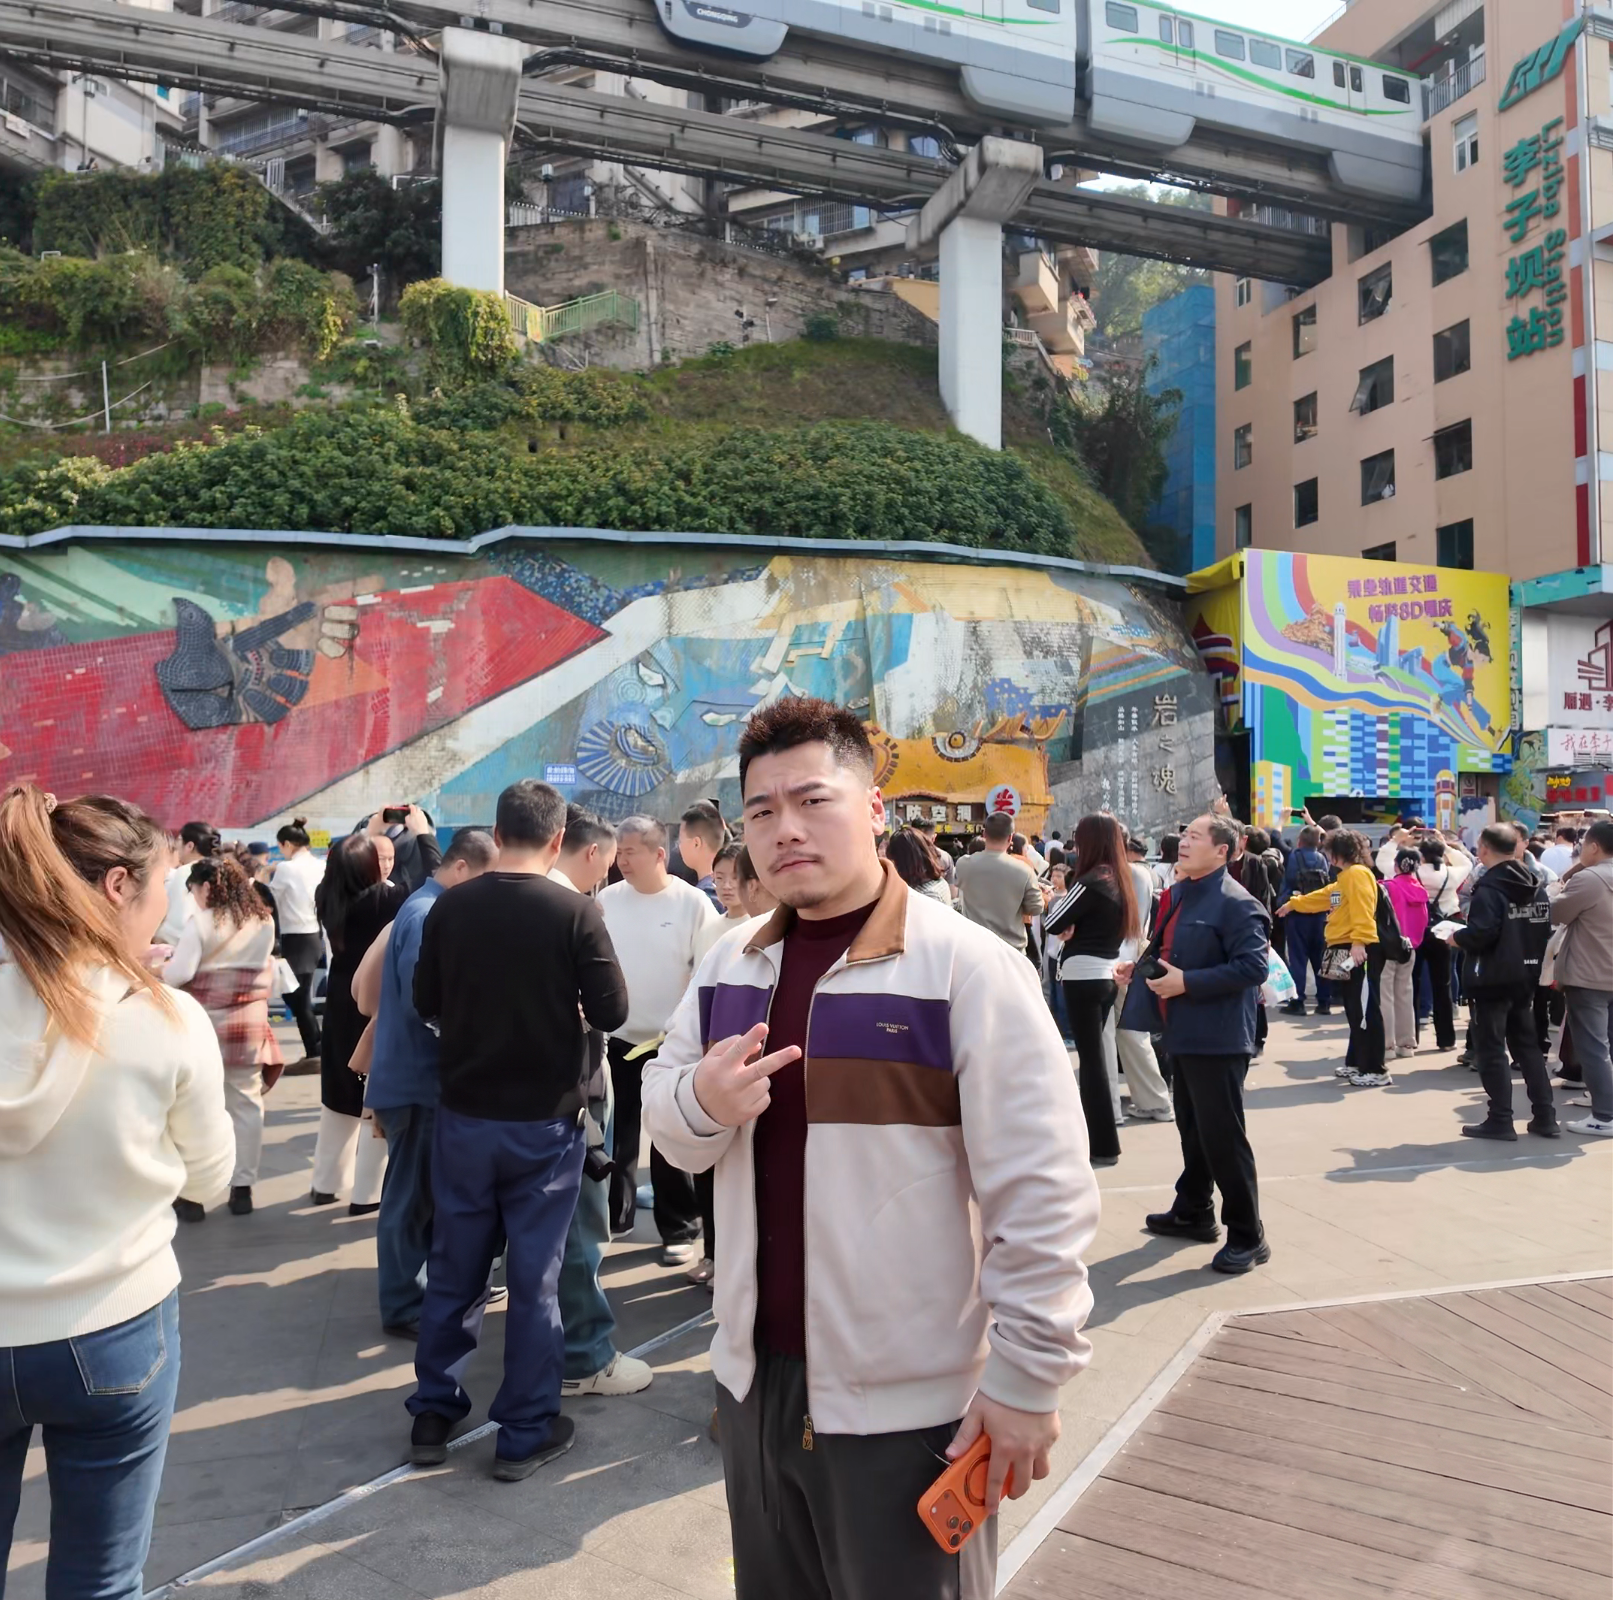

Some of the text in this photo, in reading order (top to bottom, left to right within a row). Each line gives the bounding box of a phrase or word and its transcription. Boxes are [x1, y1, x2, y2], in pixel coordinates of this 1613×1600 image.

[1503, 136, 1547, 361] 李子坝站
[1542, 115, 1567, 347] Liziba Station
[1347, 574, 1438, 598] 乘坐轨道交通
[906, 804, 972, 822] 防空洞
